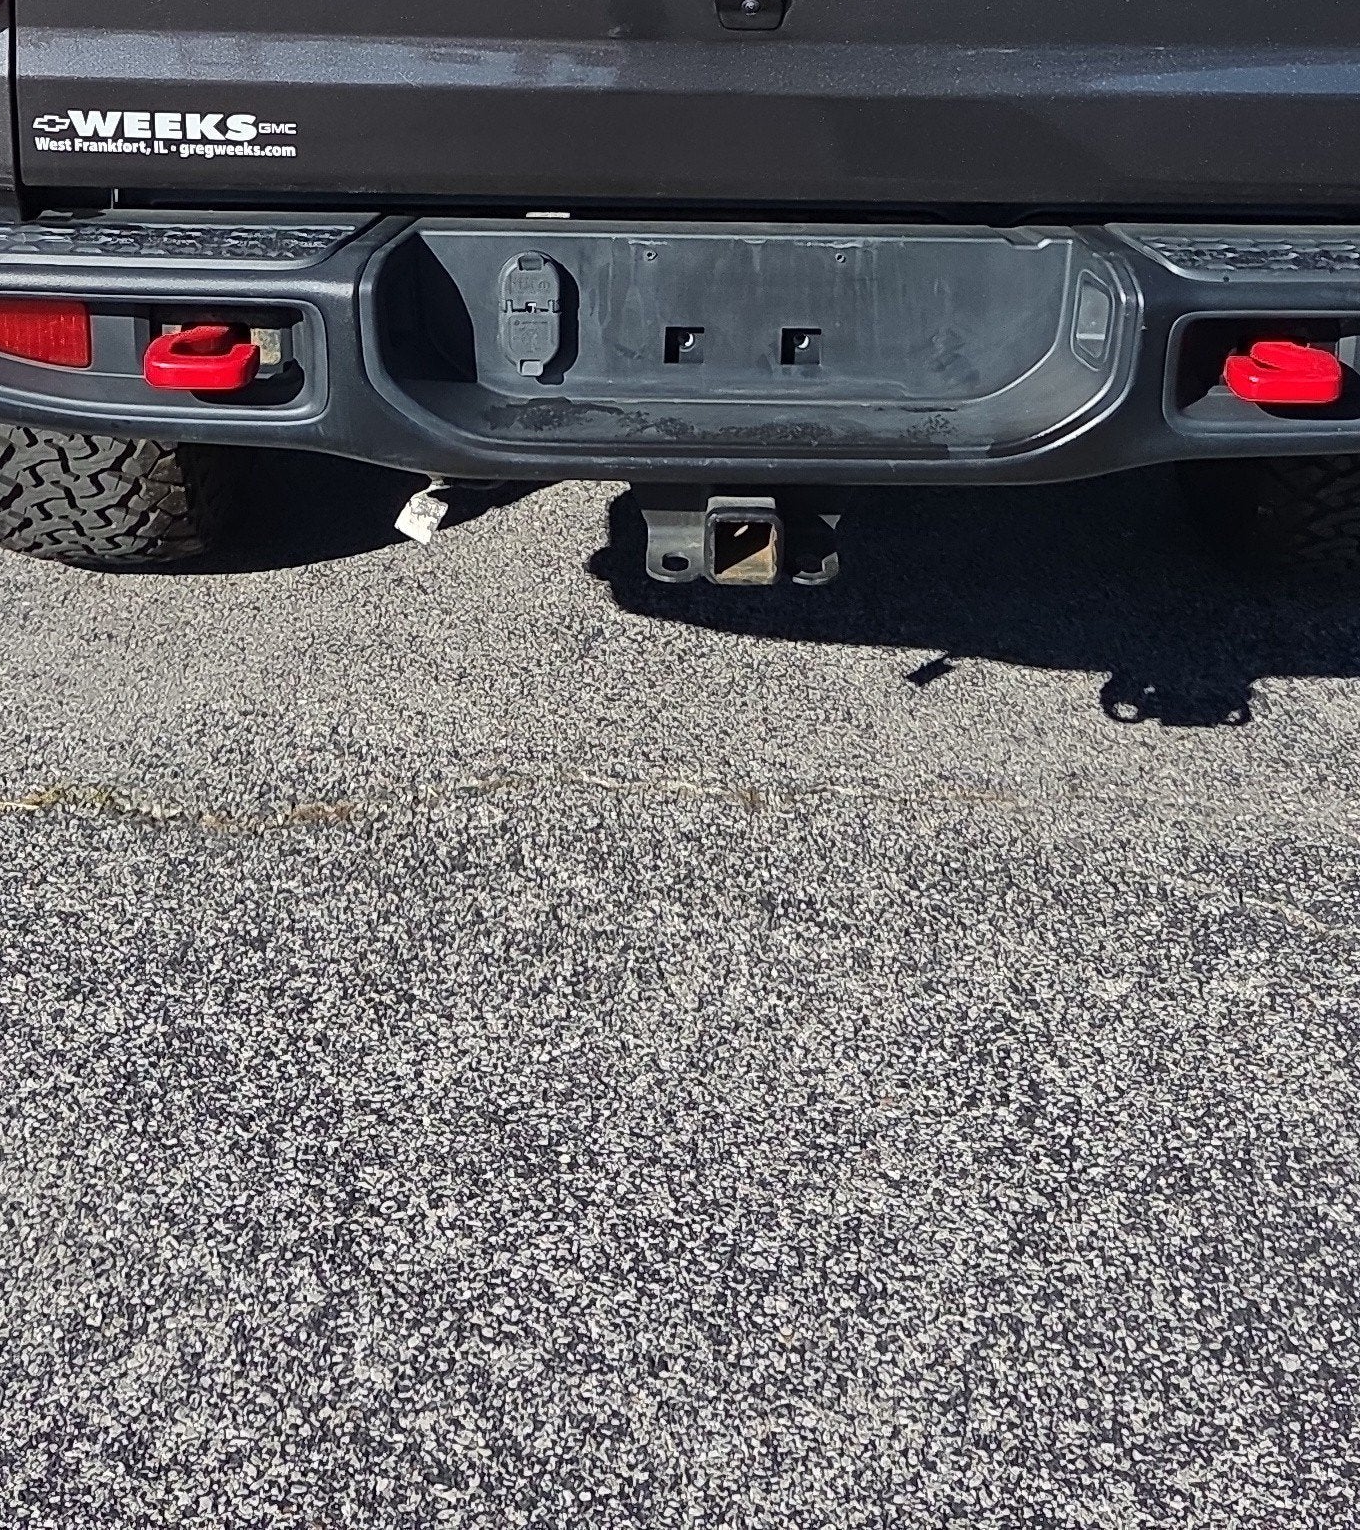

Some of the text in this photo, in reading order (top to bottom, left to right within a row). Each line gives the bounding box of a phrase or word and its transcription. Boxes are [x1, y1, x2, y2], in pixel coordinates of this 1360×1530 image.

[67, 110, 297, 141] WEEKS GMC
[34, 137, 297, 159] West Frankfort, IL gregweeks.com
